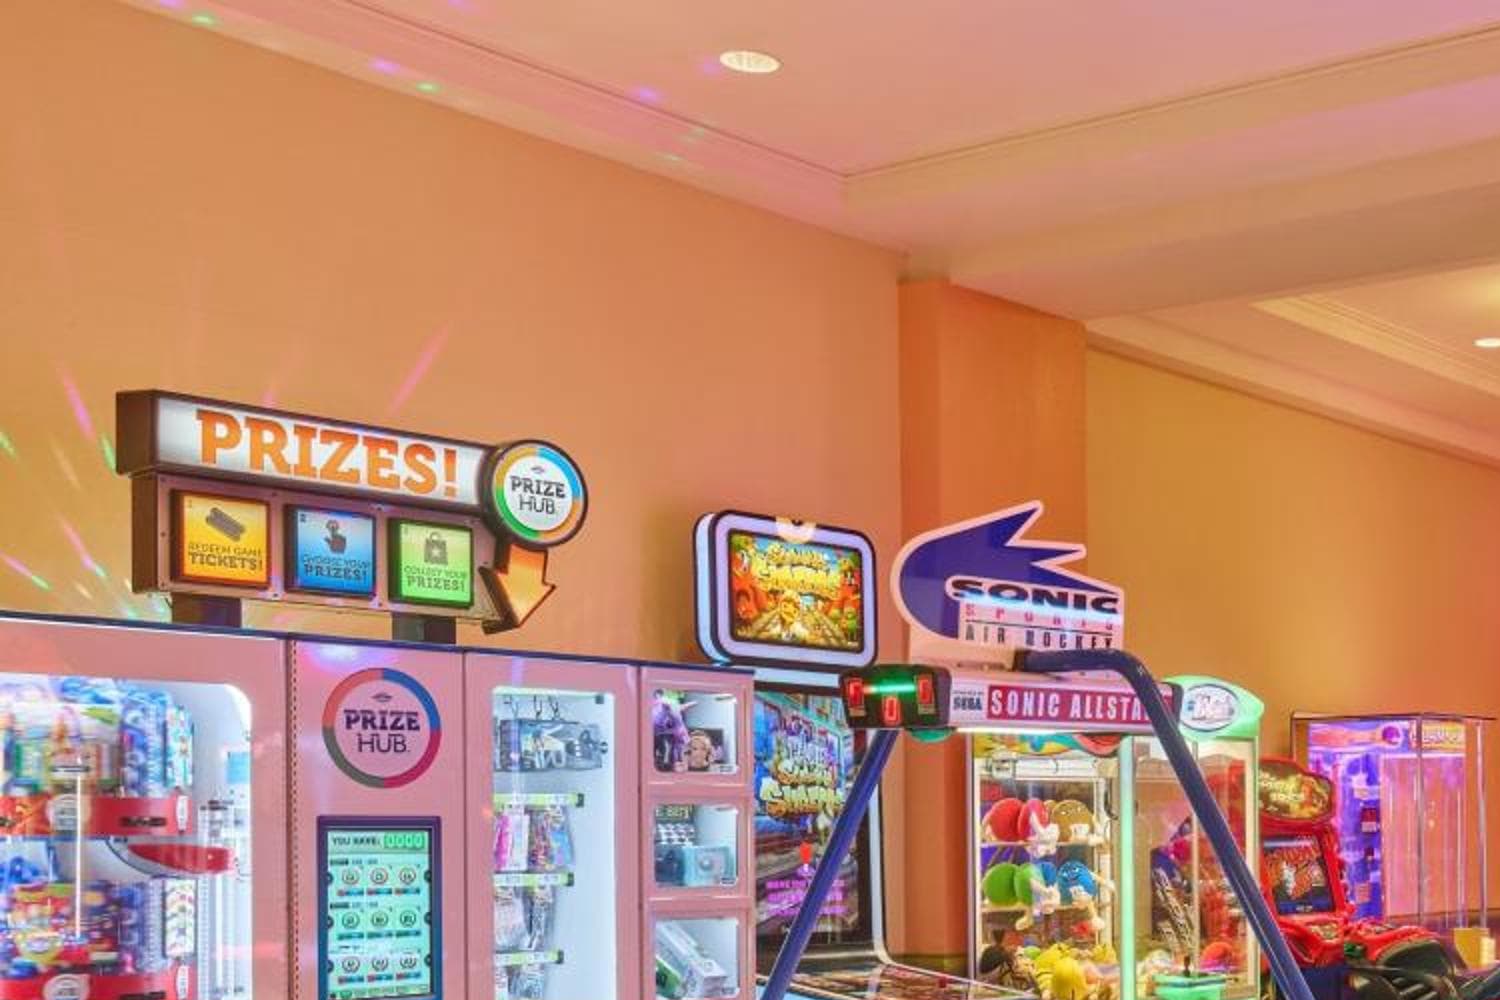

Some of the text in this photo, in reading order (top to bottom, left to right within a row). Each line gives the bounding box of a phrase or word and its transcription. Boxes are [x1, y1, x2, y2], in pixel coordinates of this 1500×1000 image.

[196, 409, 458, 498] PRIZES!
[510, 475, 567, 499] PRIZE
[518, 494, 556, 515] HUB
[188, 551, 263, 572] TICKETS!
[303, 562, 368, 583] PRIZES!
[406, 574, 466, 593] PRIZES!
[951, 579, 1119, 614] SONIC
[965, 623, 1114, 650] AIR HOCKEY
[991, 690, 1153, 720] SONIC ALLSTA
[343, 708, 421, 731] PRIZE
